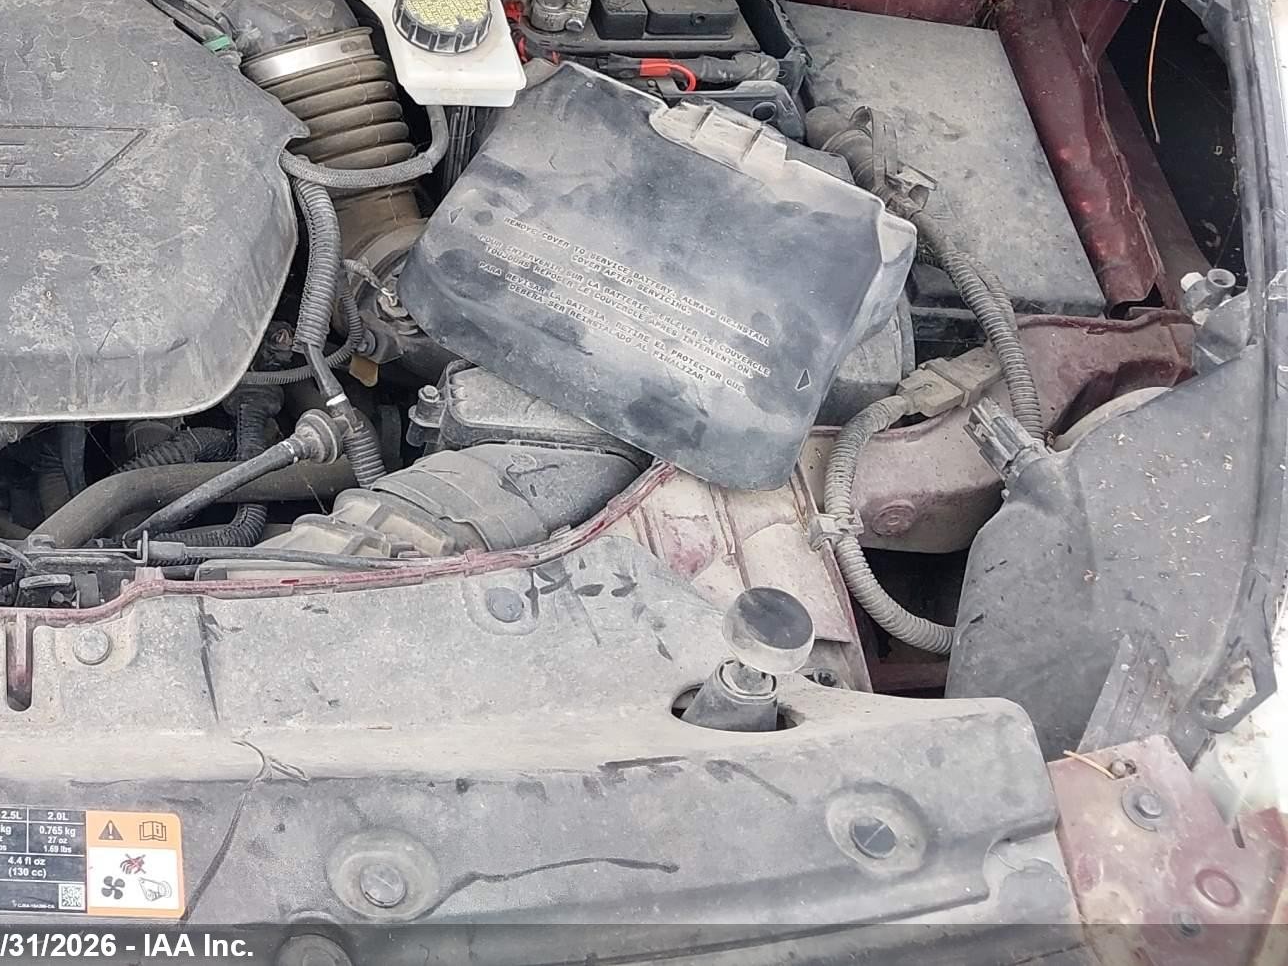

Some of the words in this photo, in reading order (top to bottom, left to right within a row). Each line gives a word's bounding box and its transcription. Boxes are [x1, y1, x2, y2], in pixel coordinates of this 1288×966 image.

[485, 245, 531, 269] TOUJOURS
[576, 285, 591, 295] LE
[593, 293, 647, 322] COUVERCLE
[504, 217, 537, 235] REMOVE
[542, 232, 571, 249] COVER
[574, 245, 586, 255] TO
[590, 252, 630, 274] SERVICE
[681, 295, 717, 317] ALWAYS
[719, 314, 770, 347] REINSTALL
[571, 255, 601, 271] COVER
[603, 268, 634, 286] AFTER
[636, 284, 691, 315] SERVICING.
[478, 262, 502, 277] PARA
[505, 273, 546, 295] REVISAR
[549, 290, 561, 302] LA
[614, 321, 651, 343] RETIRE
[653, 340, 665, 351] EL
[670, 348, 723, 381] PROTECTOR
[507, 245, 563, 272] INTERVENIR
[566, 269, 584, 282] SUR
[587, 279, 600, 290] LA
[718, 344, 771, 377] COUVERCLE
[547, 300, 566, 314] SER
[568, 308, 633, 344] REINSTALADO
[635, 341, 649, 353] AL
[1, 811, 22, 819] 2.5L
[1, 825, 11, 834] kg
[48, 812, 69, 820] 2.0L
[40, 826, 63, 834] 0.765
[65, 826, 75, 836] kg
[9, 868, 28, 877] (130
[31, 869, 47, 878] cc)
[24, 857, 31, 865] fl
